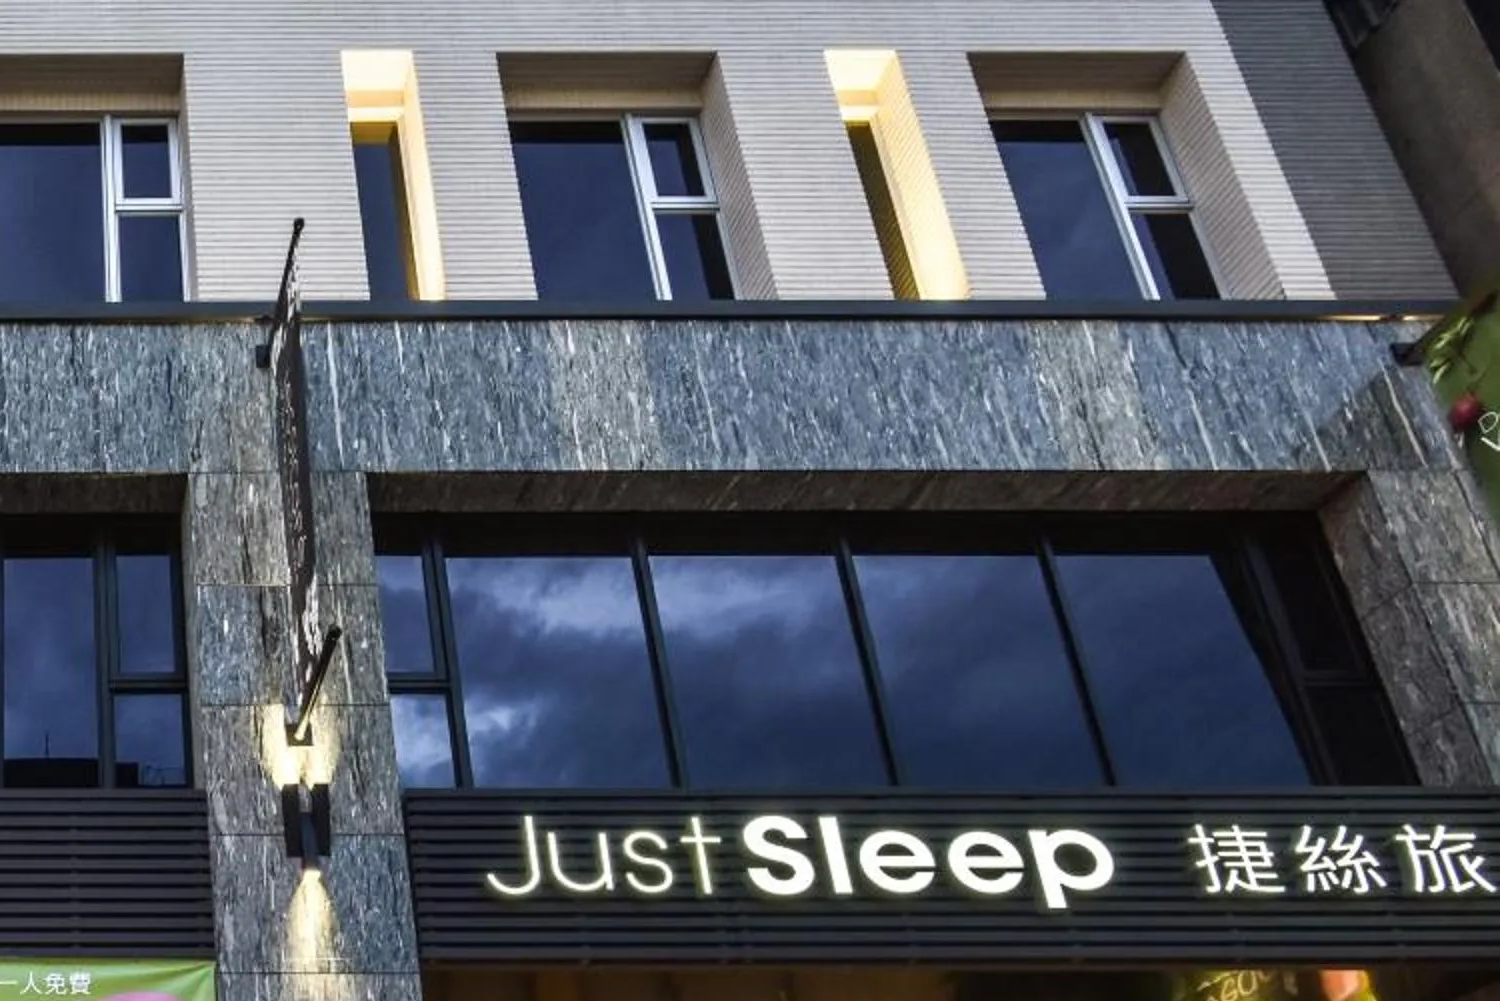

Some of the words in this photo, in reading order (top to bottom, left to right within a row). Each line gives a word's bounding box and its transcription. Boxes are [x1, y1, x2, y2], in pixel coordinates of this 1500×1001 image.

[486, 815, 721, 895] Just
[742, 815, 1114, 909] Sleep
[1187, 823, 1498, 893] 捷絲旅
